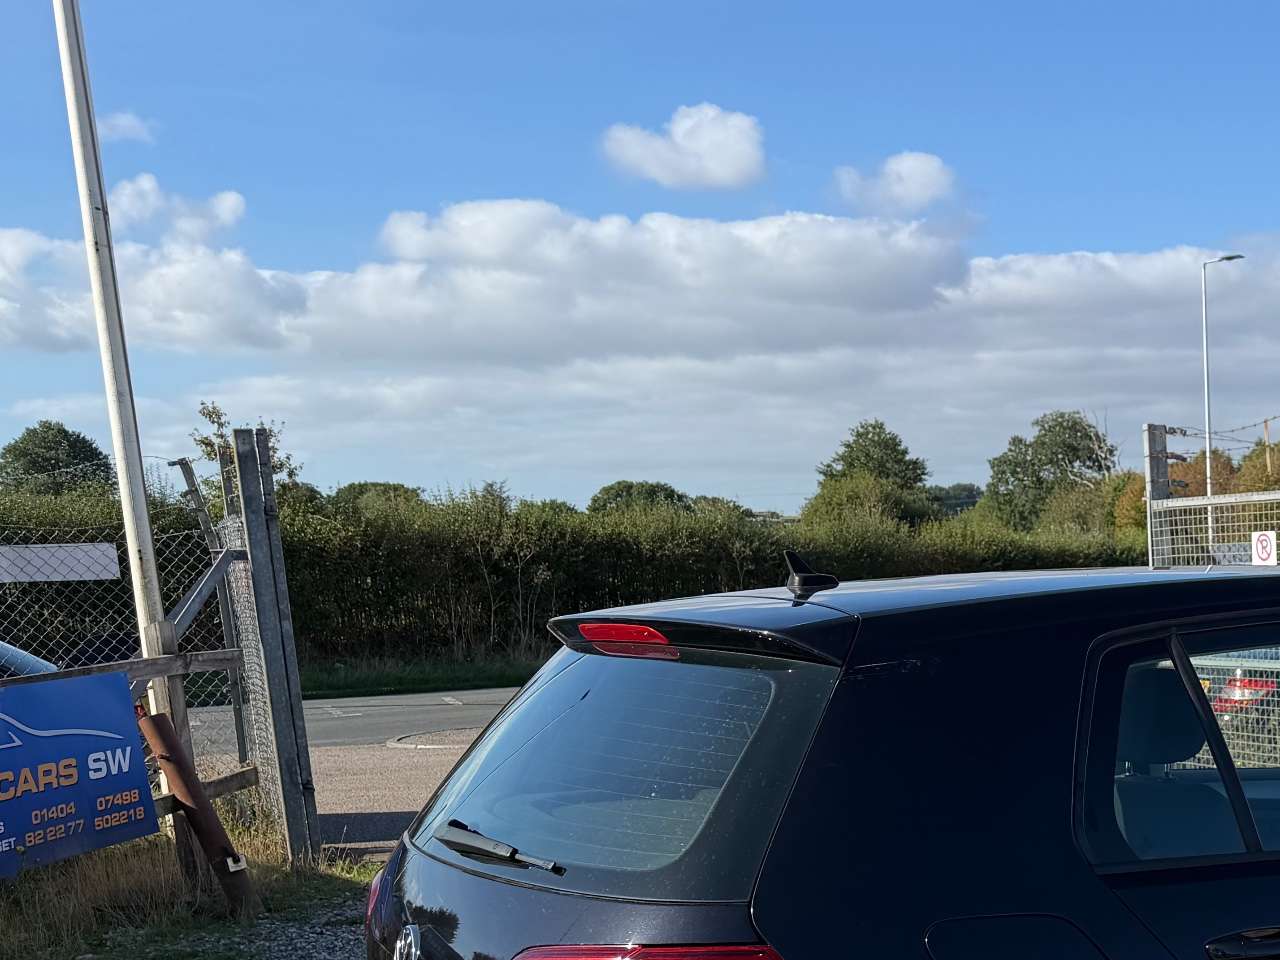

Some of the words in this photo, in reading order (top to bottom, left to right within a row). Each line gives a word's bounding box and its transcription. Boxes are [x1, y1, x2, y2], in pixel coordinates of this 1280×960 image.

[0, 757, 79, 801] CARS
[87, 746, 132, 780] SW
[96, 789, 140, 811] 07498
[31, 802, 76, 824] 01404
